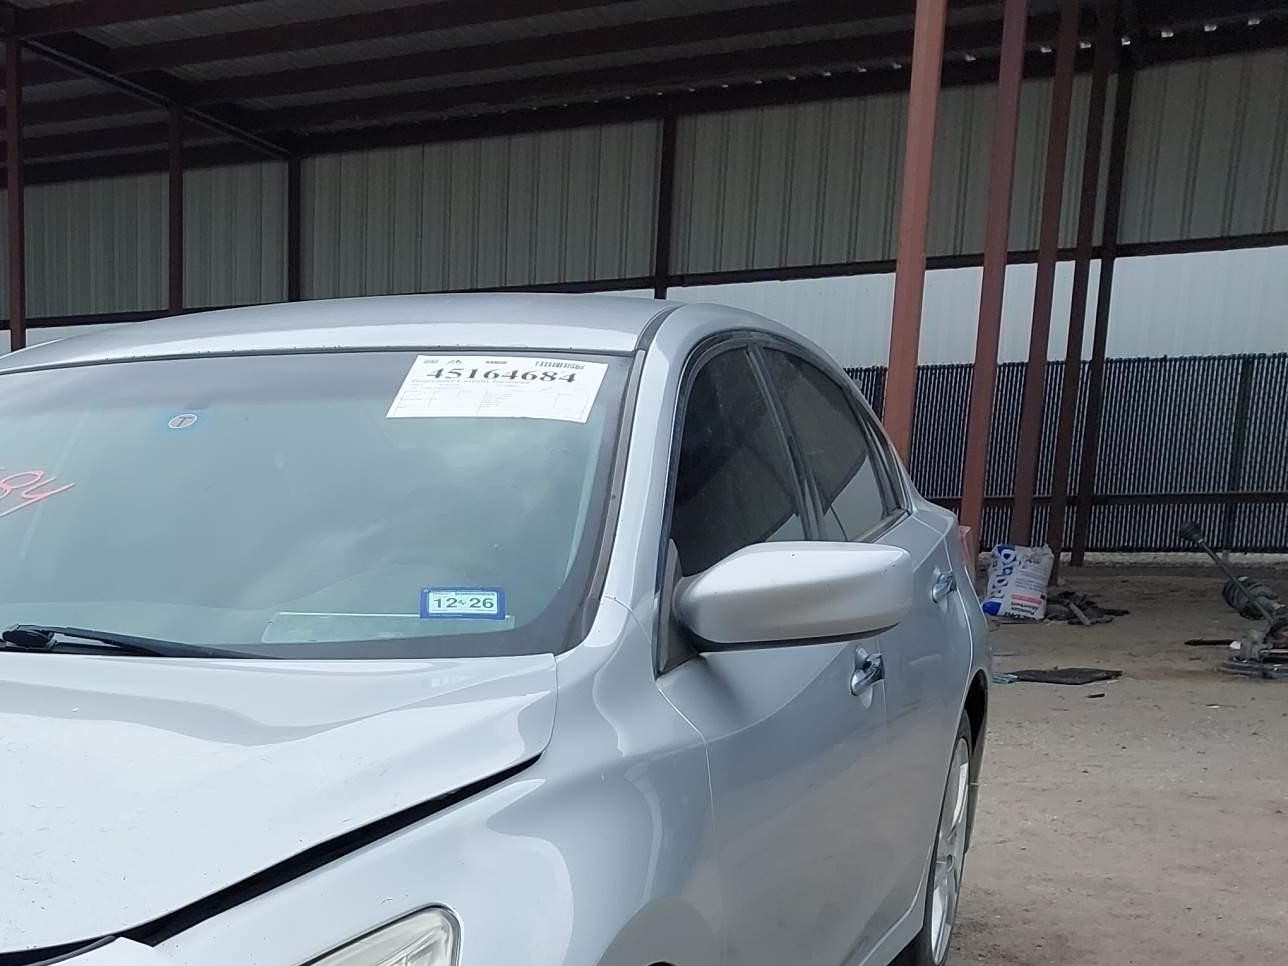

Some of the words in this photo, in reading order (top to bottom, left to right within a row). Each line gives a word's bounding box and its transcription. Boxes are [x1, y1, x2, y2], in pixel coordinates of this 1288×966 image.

[427, 367, 576, 383] 45164684
[434, 598, 458, 609] 12
[469, 598, 494, 608] 26
